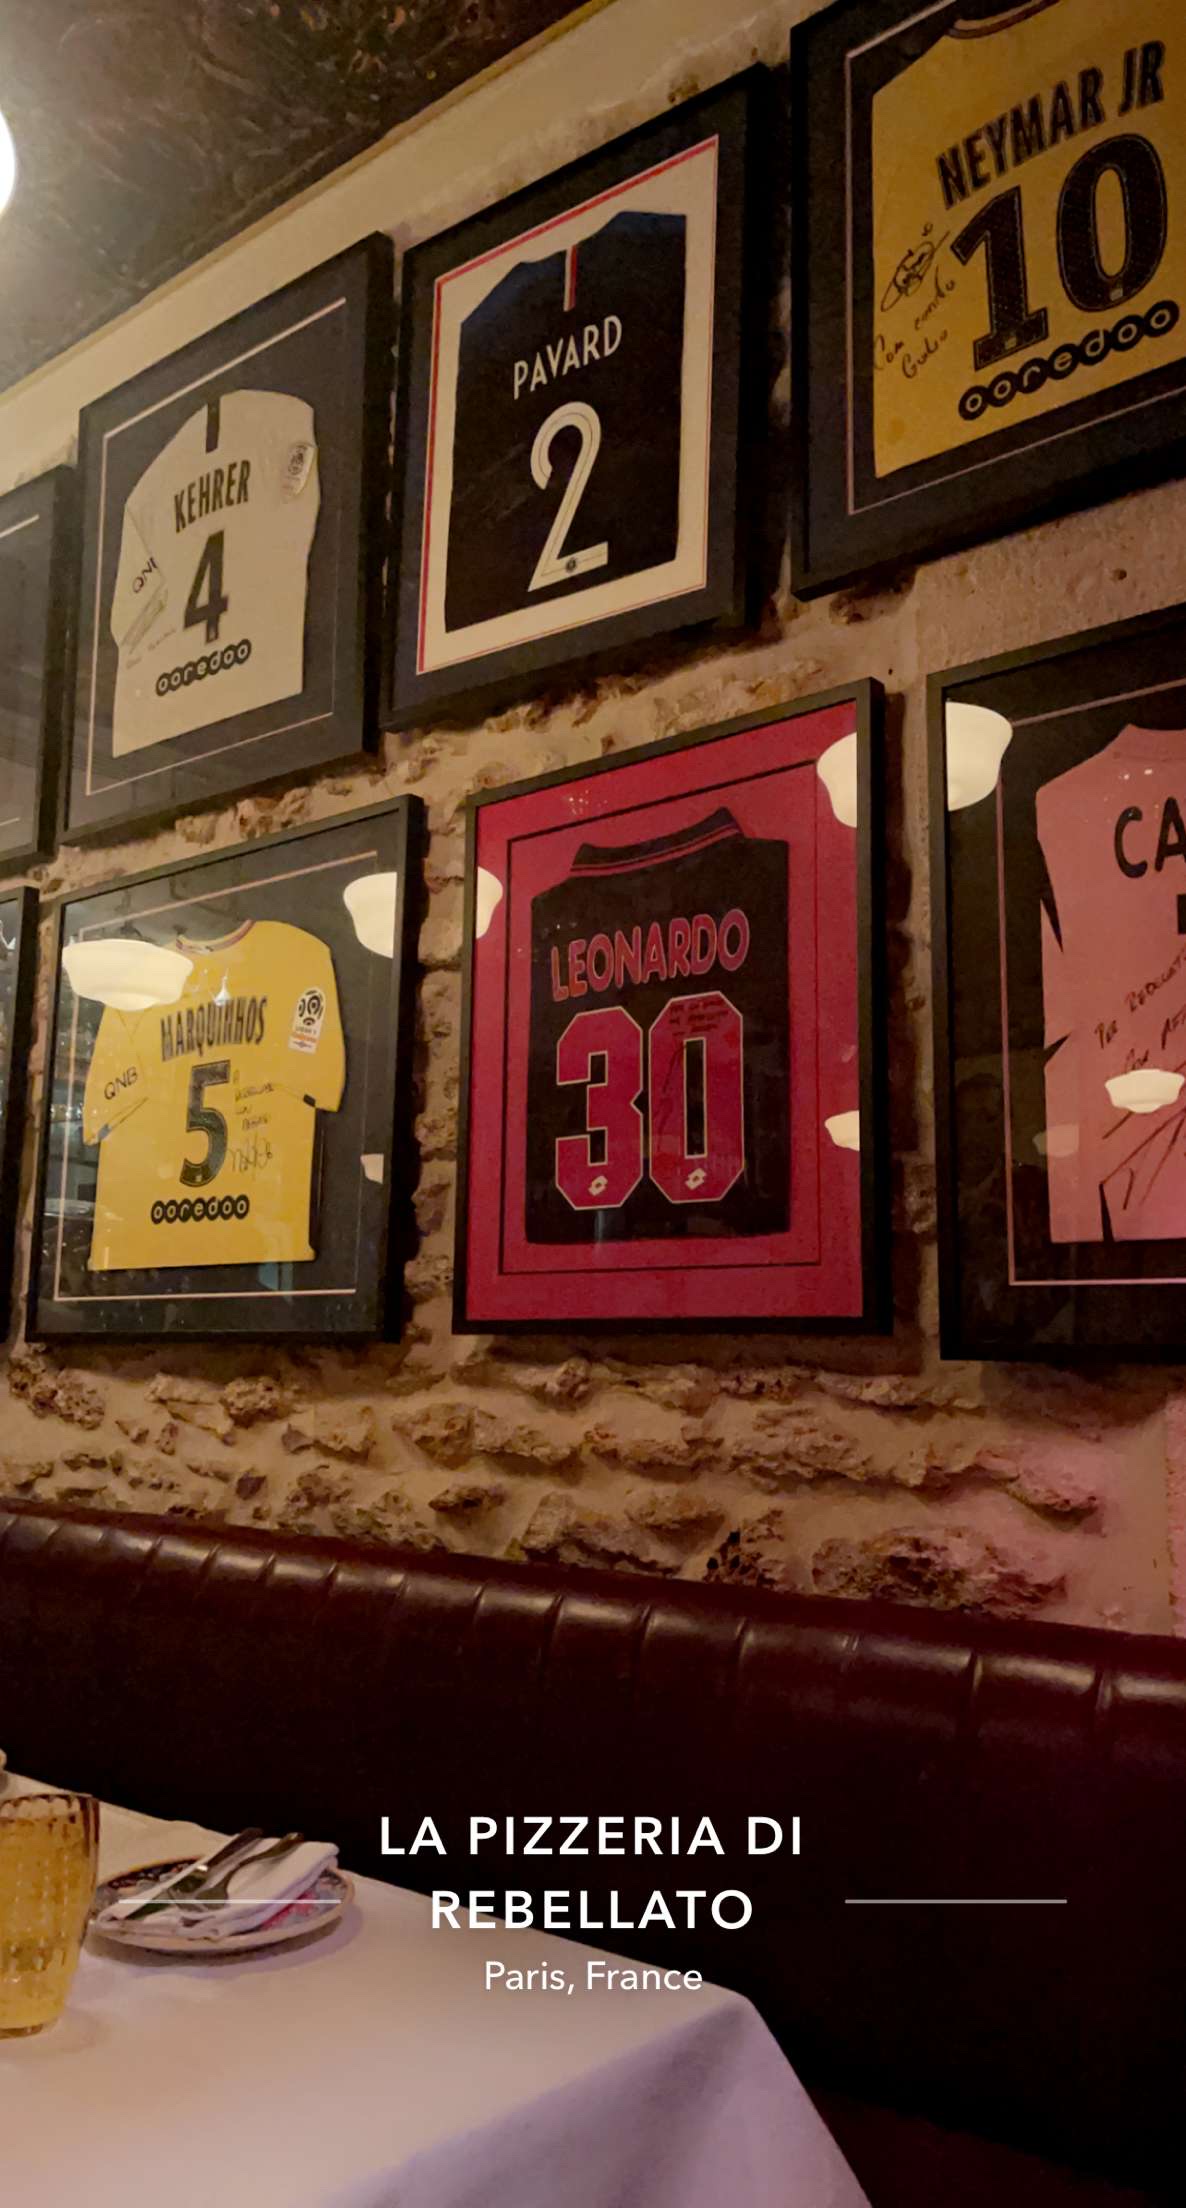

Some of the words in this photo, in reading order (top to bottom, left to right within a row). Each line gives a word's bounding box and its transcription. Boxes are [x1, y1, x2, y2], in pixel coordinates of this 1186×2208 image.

[936, 65, 1106, 211] NEYMAR
[1118, 40, 1167, 118] JR
[950, 133, 1168, 372] 10
[513, 314, 622, 400] PAVARD
[958, 300, 1180, 420] ooredoo
[174, 459, 251, 534] KEHRER
[527, 401, 609, 593] 2
[132, 557, 158, 594] QN
[183, 529, 230, 646] 4
[156, 638, 252, 697] ooredoo
[551, 909, 750, 1002] LEONARDO
[160, 996, 268, 1062] MARQUINHOS
[104, 1066, 138, 1100] QNB
[179, 1059, 231, 1188] 5
[555, 990, 745, 1210] 30
[151, 1194, 250, 1225] ooredoo
